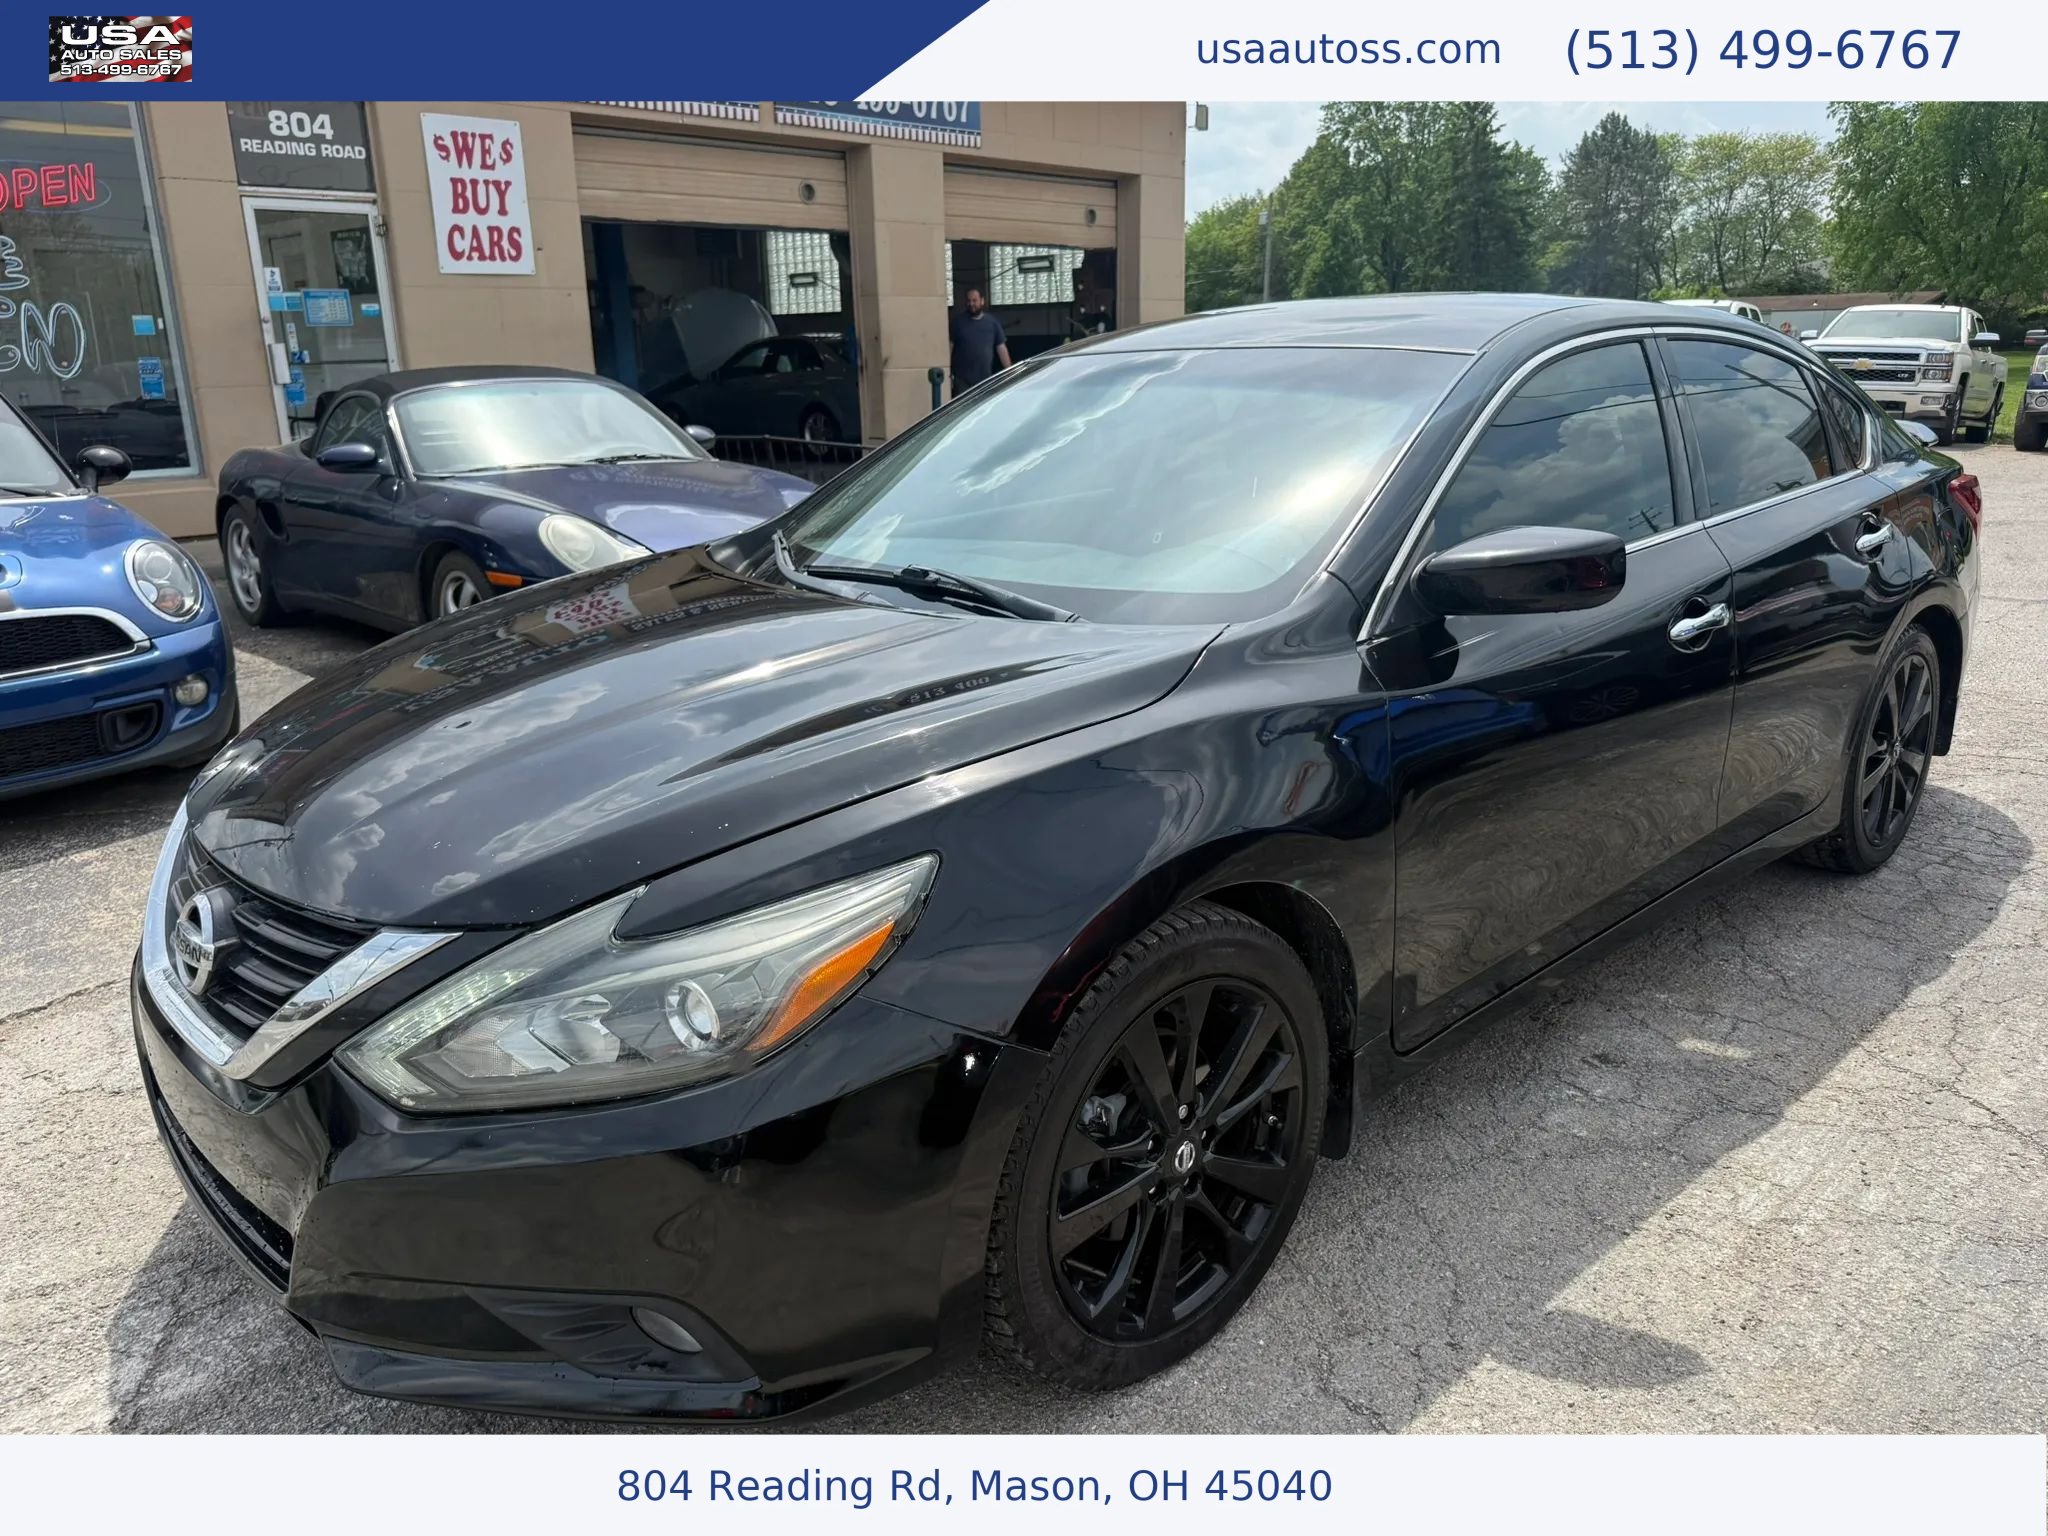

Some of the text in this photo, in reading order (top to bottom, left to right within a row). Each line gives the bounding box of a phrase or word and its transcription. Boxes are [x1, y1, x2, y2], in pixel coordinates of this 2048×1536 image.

[267, 109, 334, 140] 804
[239, 138, 367, 160] READING ROAD
[449, 176, 513, 217] BUY
[447, 223, 524, 263] CARS
